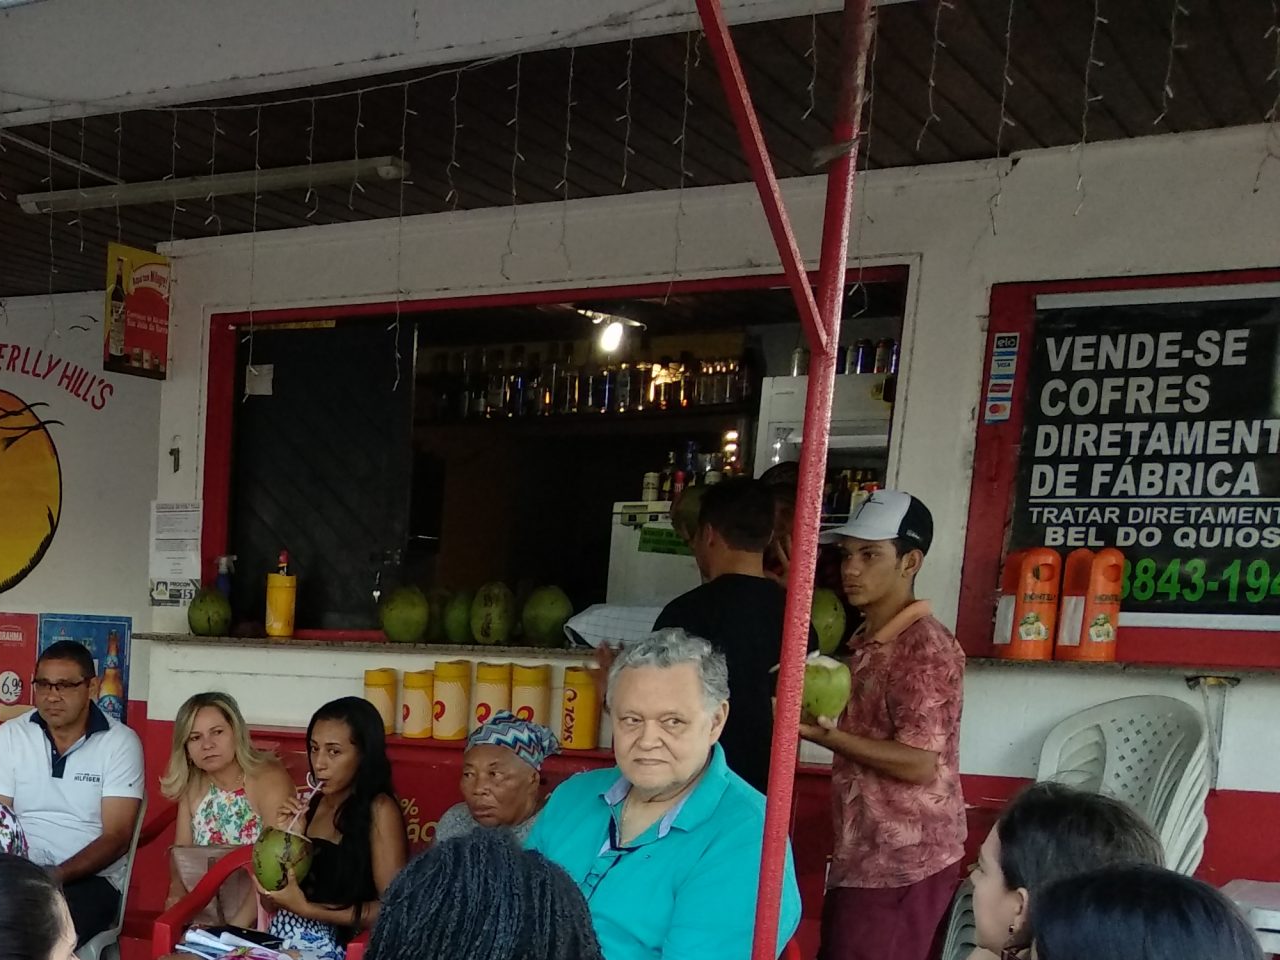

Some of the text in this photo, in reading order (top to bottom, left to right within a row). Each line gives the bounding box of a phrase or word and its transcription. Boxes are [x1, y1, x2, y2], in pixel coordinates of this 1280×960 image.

[1046, 328, 1250, 372] VENDE-SE
[57, 361, 114, 411] HILL'S
[1040, 374, 1211, 417] COFRES
[1029, 457, 1260, 497] DE FÁBRICA
[1028, 507, 1120, 524] TRATAR
[1044, 526, 1280, 549] BEL DO QUIOS
[563, 706, 576, 743] SKOL
[74, 775, 101, 783] HILFIGER
